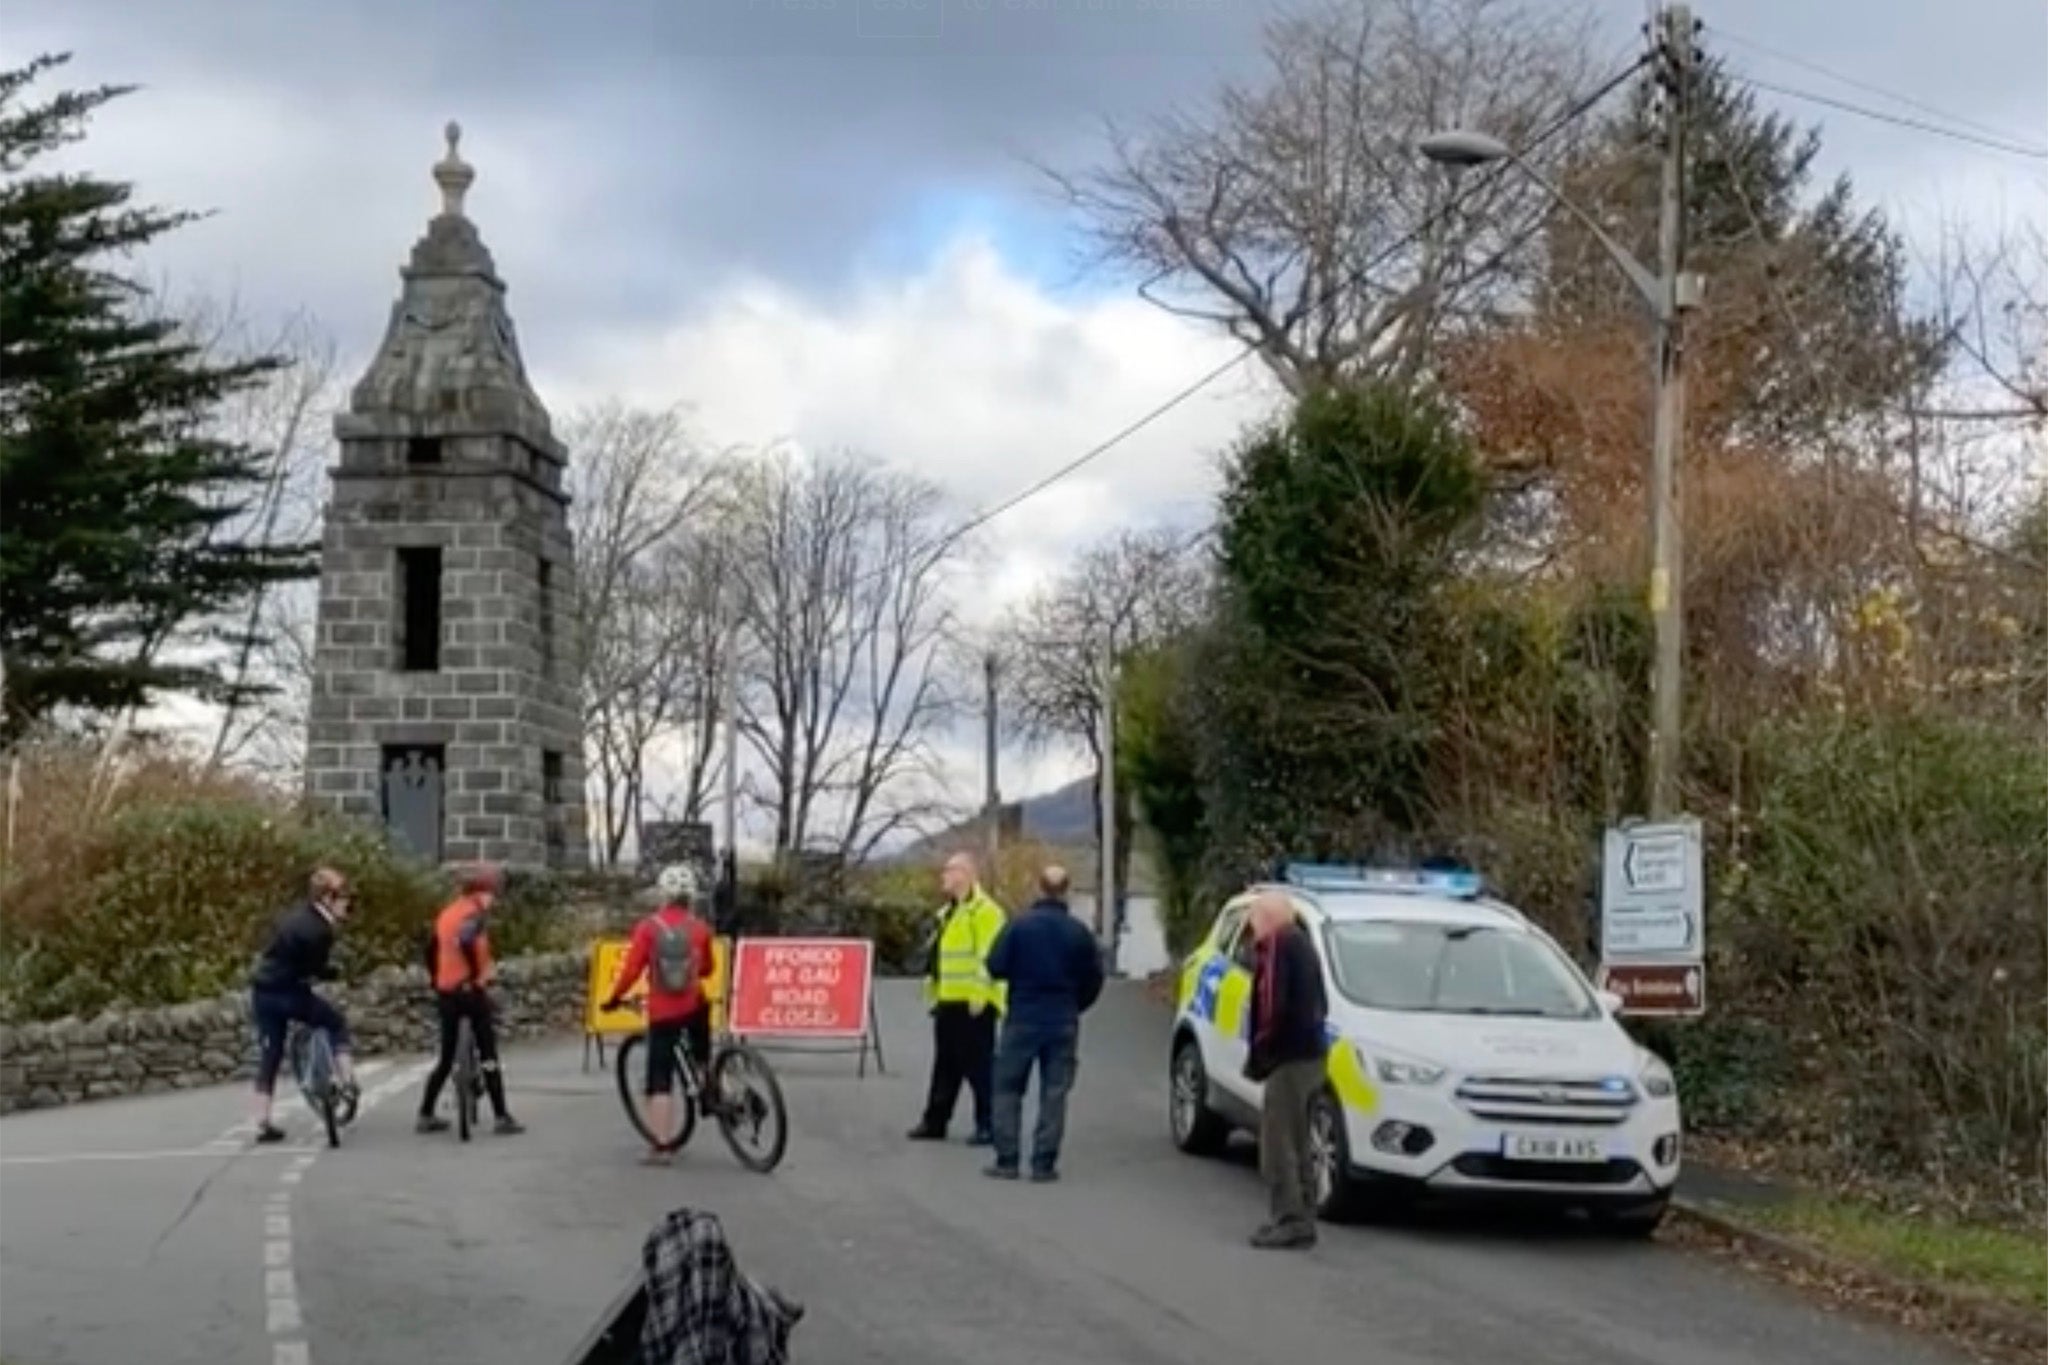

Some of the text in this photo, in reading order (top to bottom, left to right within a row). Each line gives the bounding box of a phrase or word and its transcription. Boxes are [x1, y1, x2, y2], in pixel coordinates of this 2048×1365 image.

[764, 966, 841, 985] AR GAU
[771, 987, 829, 1005] ROAD
[758, 1007, 839, 1025] CLOSED
